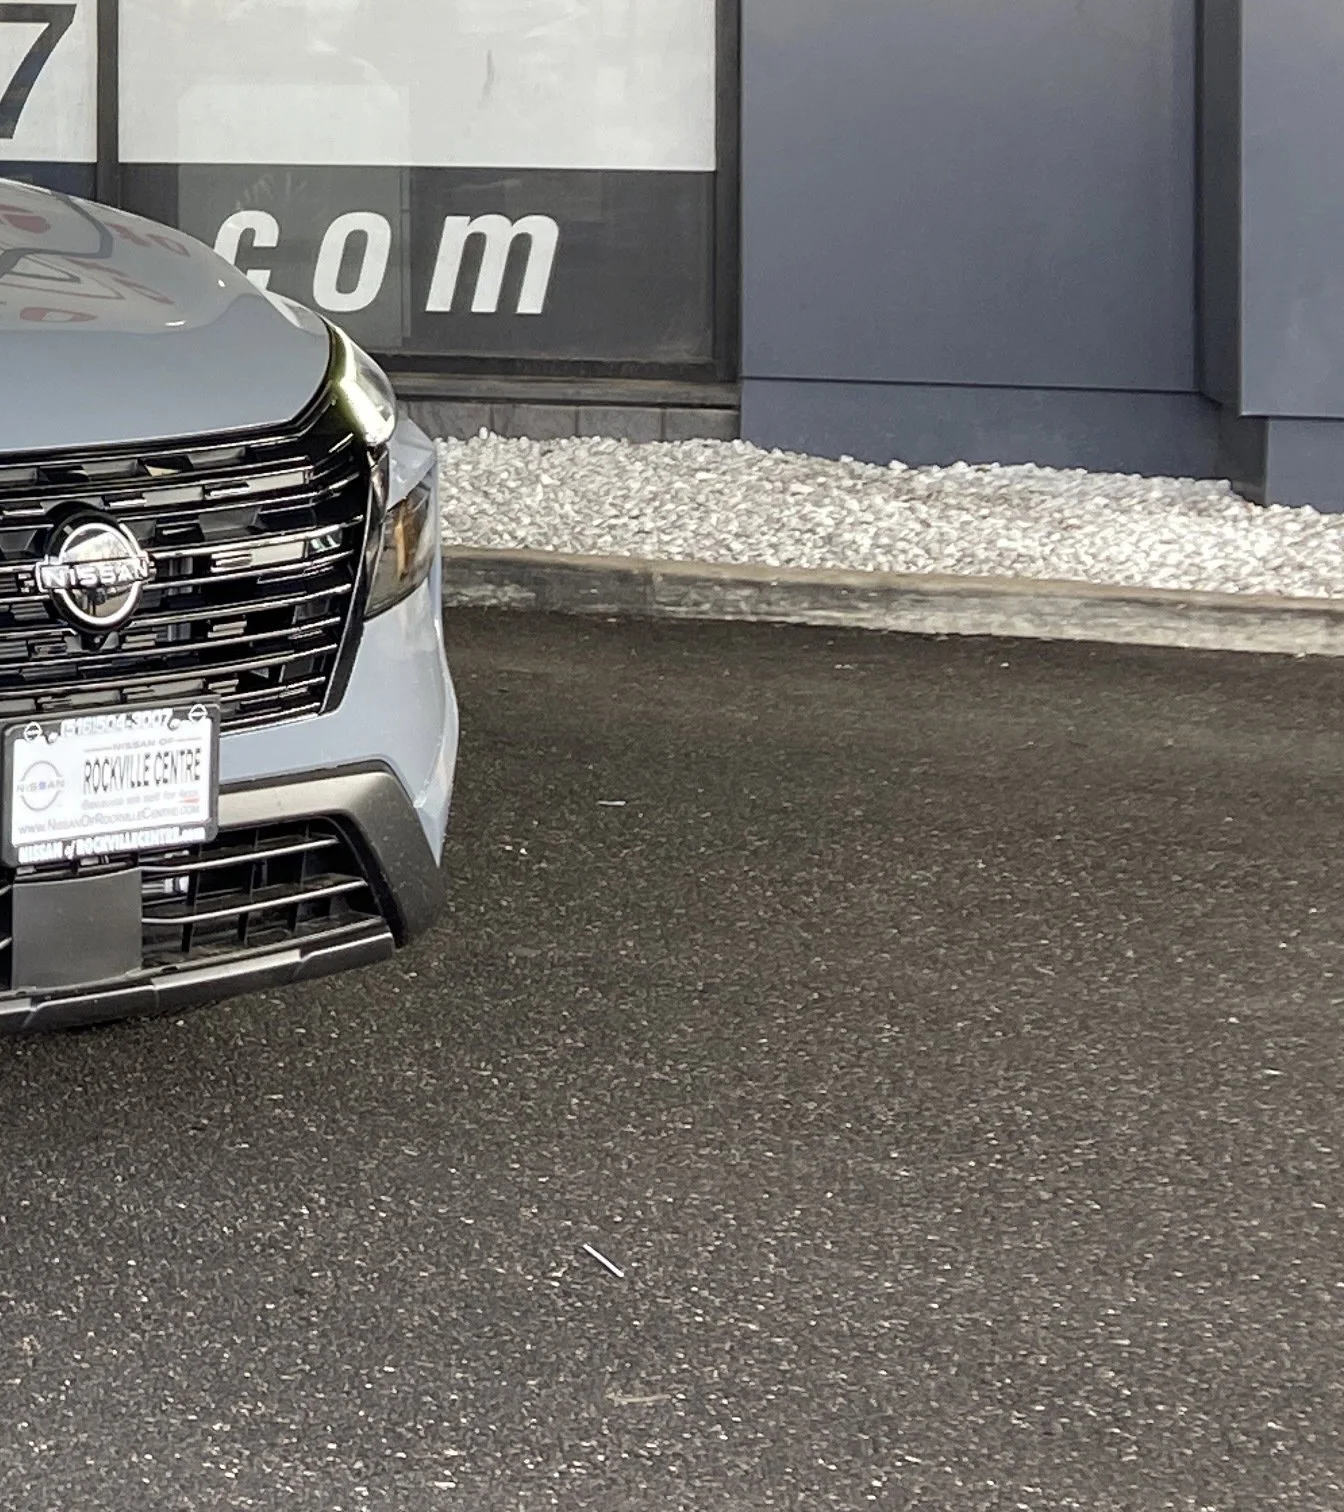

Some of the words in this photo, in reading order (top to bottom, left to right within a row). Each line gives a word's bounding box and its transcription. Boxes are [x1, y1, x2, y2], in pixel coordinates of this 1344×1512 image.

[42, 558, 148, 588] NISSAN
[83, 753, 152, 795] ROCKVILLE
[154, 748, 202, 786] CENTRE
[18, 841, 63, 864] NISSAN
